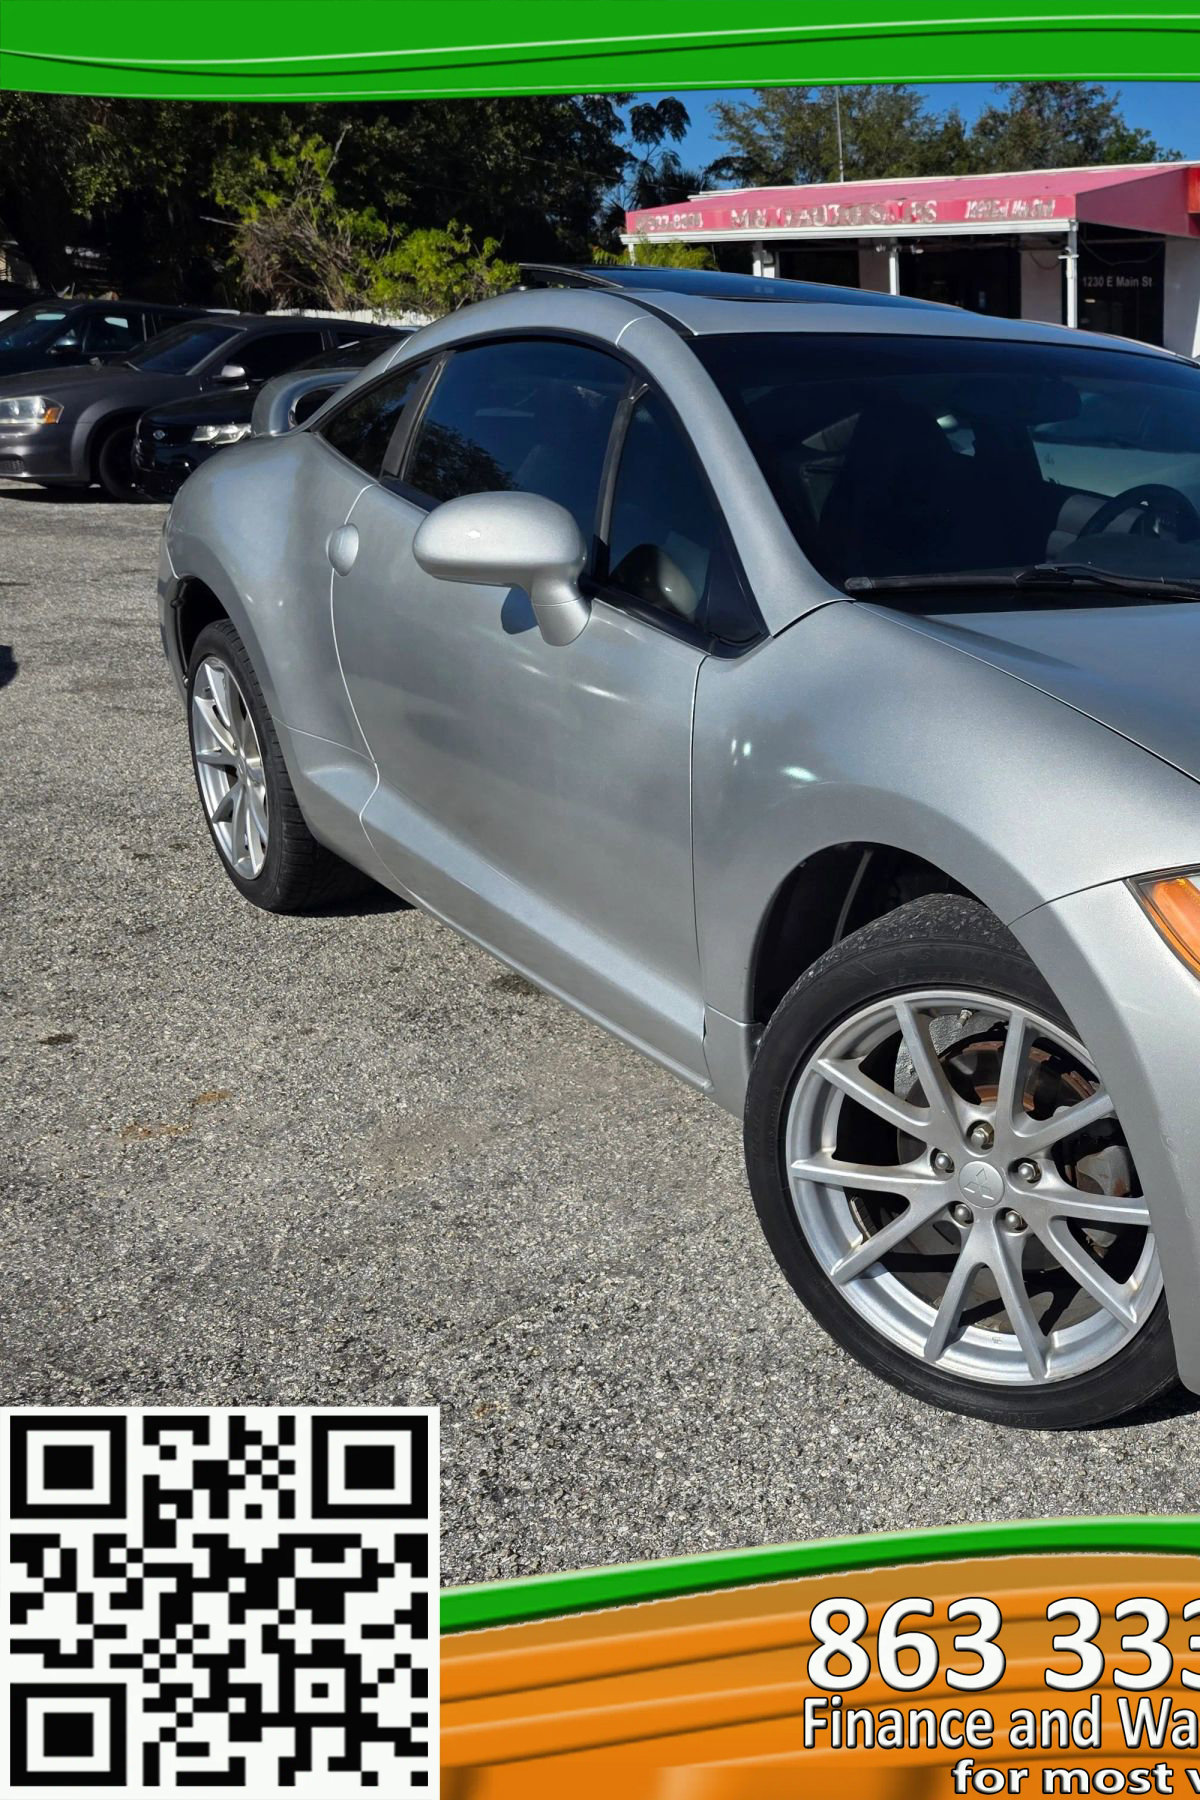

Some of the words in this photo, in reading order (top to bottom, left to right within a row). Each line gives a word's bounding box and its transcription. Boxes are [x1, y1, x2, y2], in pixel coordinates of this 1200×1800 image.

[1082, 276, 1104, 288] 1230
[1106, 276, 1113, 287] E
[1116, 276, 1139, 287] Main
[1142, 276, 1153, 287] St
